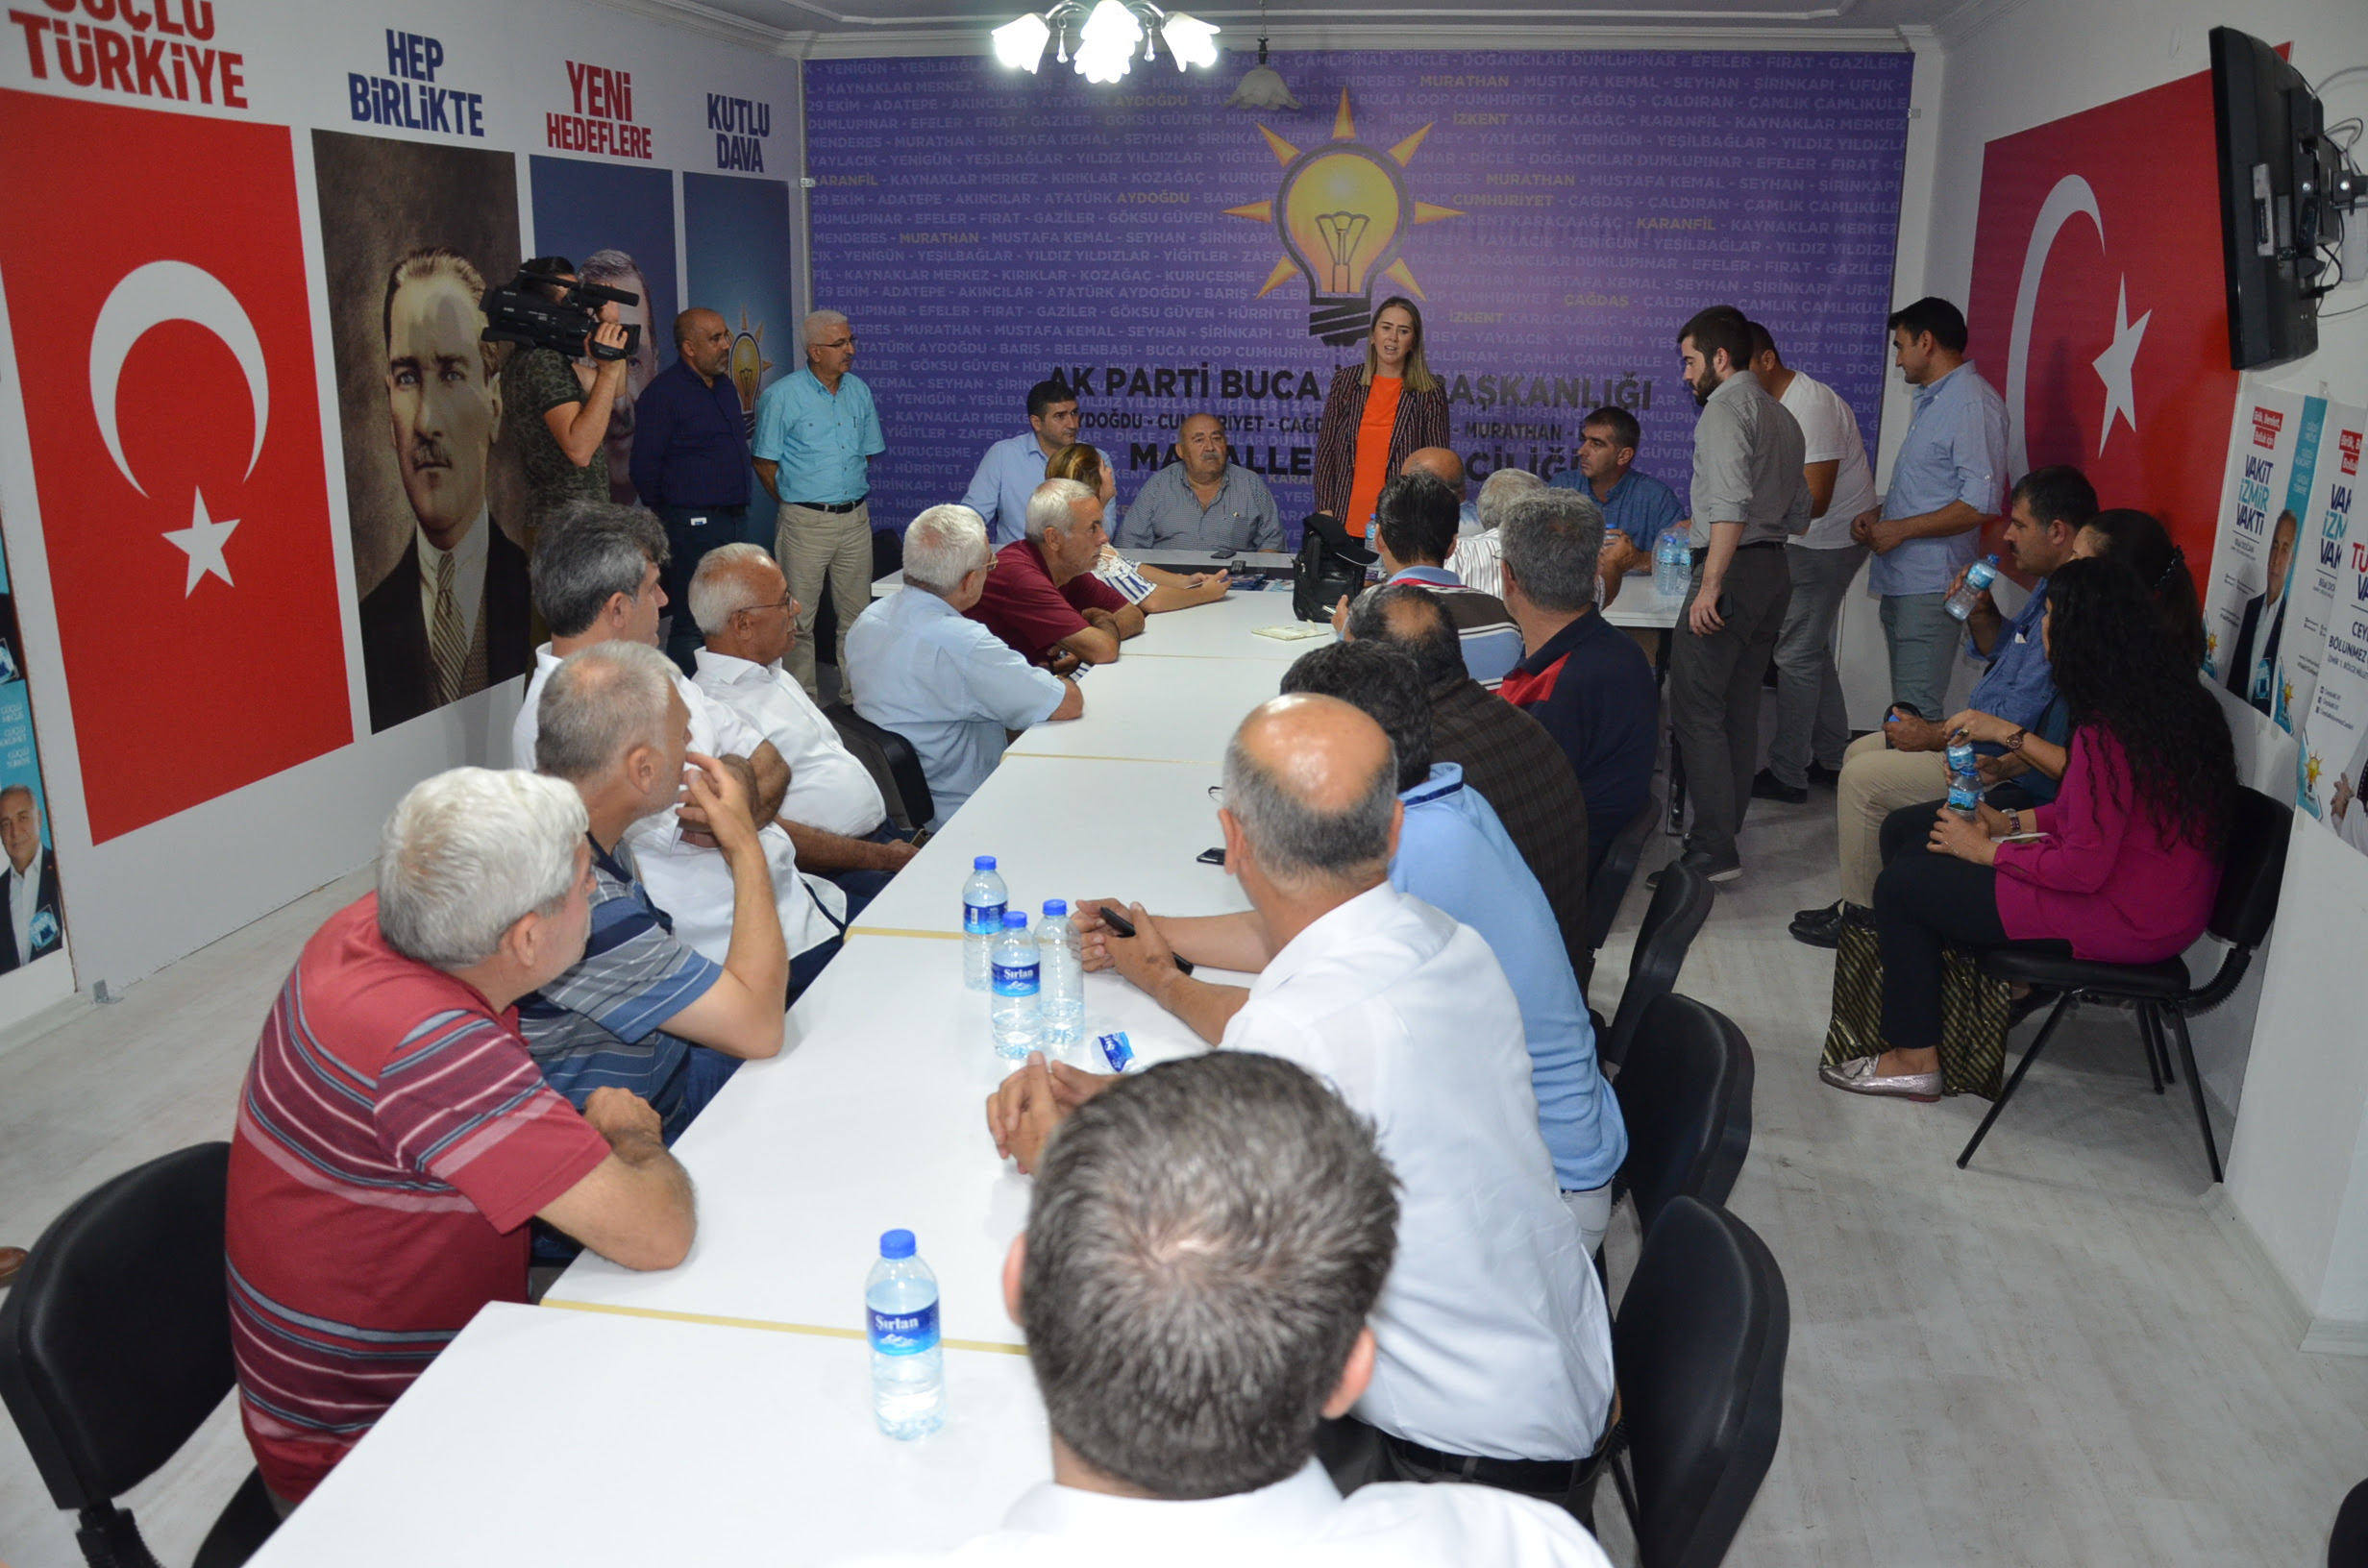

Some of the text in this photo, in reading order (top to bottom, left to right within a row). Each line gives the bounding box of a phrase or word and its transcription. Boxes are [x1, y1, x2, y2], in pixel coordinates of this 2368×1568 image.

[9, 9, 248, 109] TÜRKİYE
[385, 28, 443, 83] HEP
[565, 60, 632, 121] YENİ
[1419, 75, 1509, 87] MURATHAN
[348, 72, 484, 137] BİRLİKTE
[706, 92, 770, 137] KUTLU
[873, 98, 938, 110] ADATEPE
[546, 111, 652, 159] HEDEFLERE
[894, 135, 975, 147] MURATHAN
[716, 133, 764, 173] DAVA
[1487, 174, 1575, 186] MURATHAN
[877, 193, 942, 205] ADATEPE
[1117, 187, 1190, 205] AYDOĞDU
[814, 213, 903, 225] DUMLUPINAR
[915, 213, 967, 225] EFELER
[980, 212, 1021, 224] FIRAT
[1637, 215, 1716, 231] KARANFİL
[814, 233, 1185, 245] MENDERES MURATHAN MUSTAFA KEMAL SEYHAN
[1026, 250, 1072, 262] YILDIZ
[1075, 250, 1150, 262] YILDIZLAR
[1692, 258, 1749, 272] EFELER
[846, 270, 929, 282] KAYNAKLAR
[933, 270, 989, 282] MERKEZ
[1002, 270, 1067, 282] KIRIKLAR
[883, 285, 945, 298] ADATEPE
[958, 286, 1033, 299] AKINCILAR
[1564, 292, 1629, 309] ÇAĞDAŞ
[919, 306, 971, 317] EFELER
[983, 306, 1024, 318] FIRAT
[903, 325, 981, 336] MURATHAN
[994, 325, 1063, 337] MUSTAFA
[1066, 326, 1115, 337] KEMAL
[1127, 326, 1187, 338] SEYHAN
[1146, 345, 1186, 357] BUCA
[1191, 346, 1231, 358] KOOP
[927, 378, 981, 390] SEYHAN
[1049, 366, 1095, 399] AK
[1105, 360, 1208, 400] PARTİ
[1221, 368, 1322, 402] BUCA
[896, 411, 978, 424] KAYNAKLAR
[1077, 407, 1561, 442] YDOĞDU CUMRİYET ÇAĞD MURATHAN
[1130, 443, 1313, 476] MAALLE
[2245, 454, 2274, 485] VAKİT
[2238, 478, 2270, 512] İZMİR
[2236, 502, 2265, 535] VAKTİ
